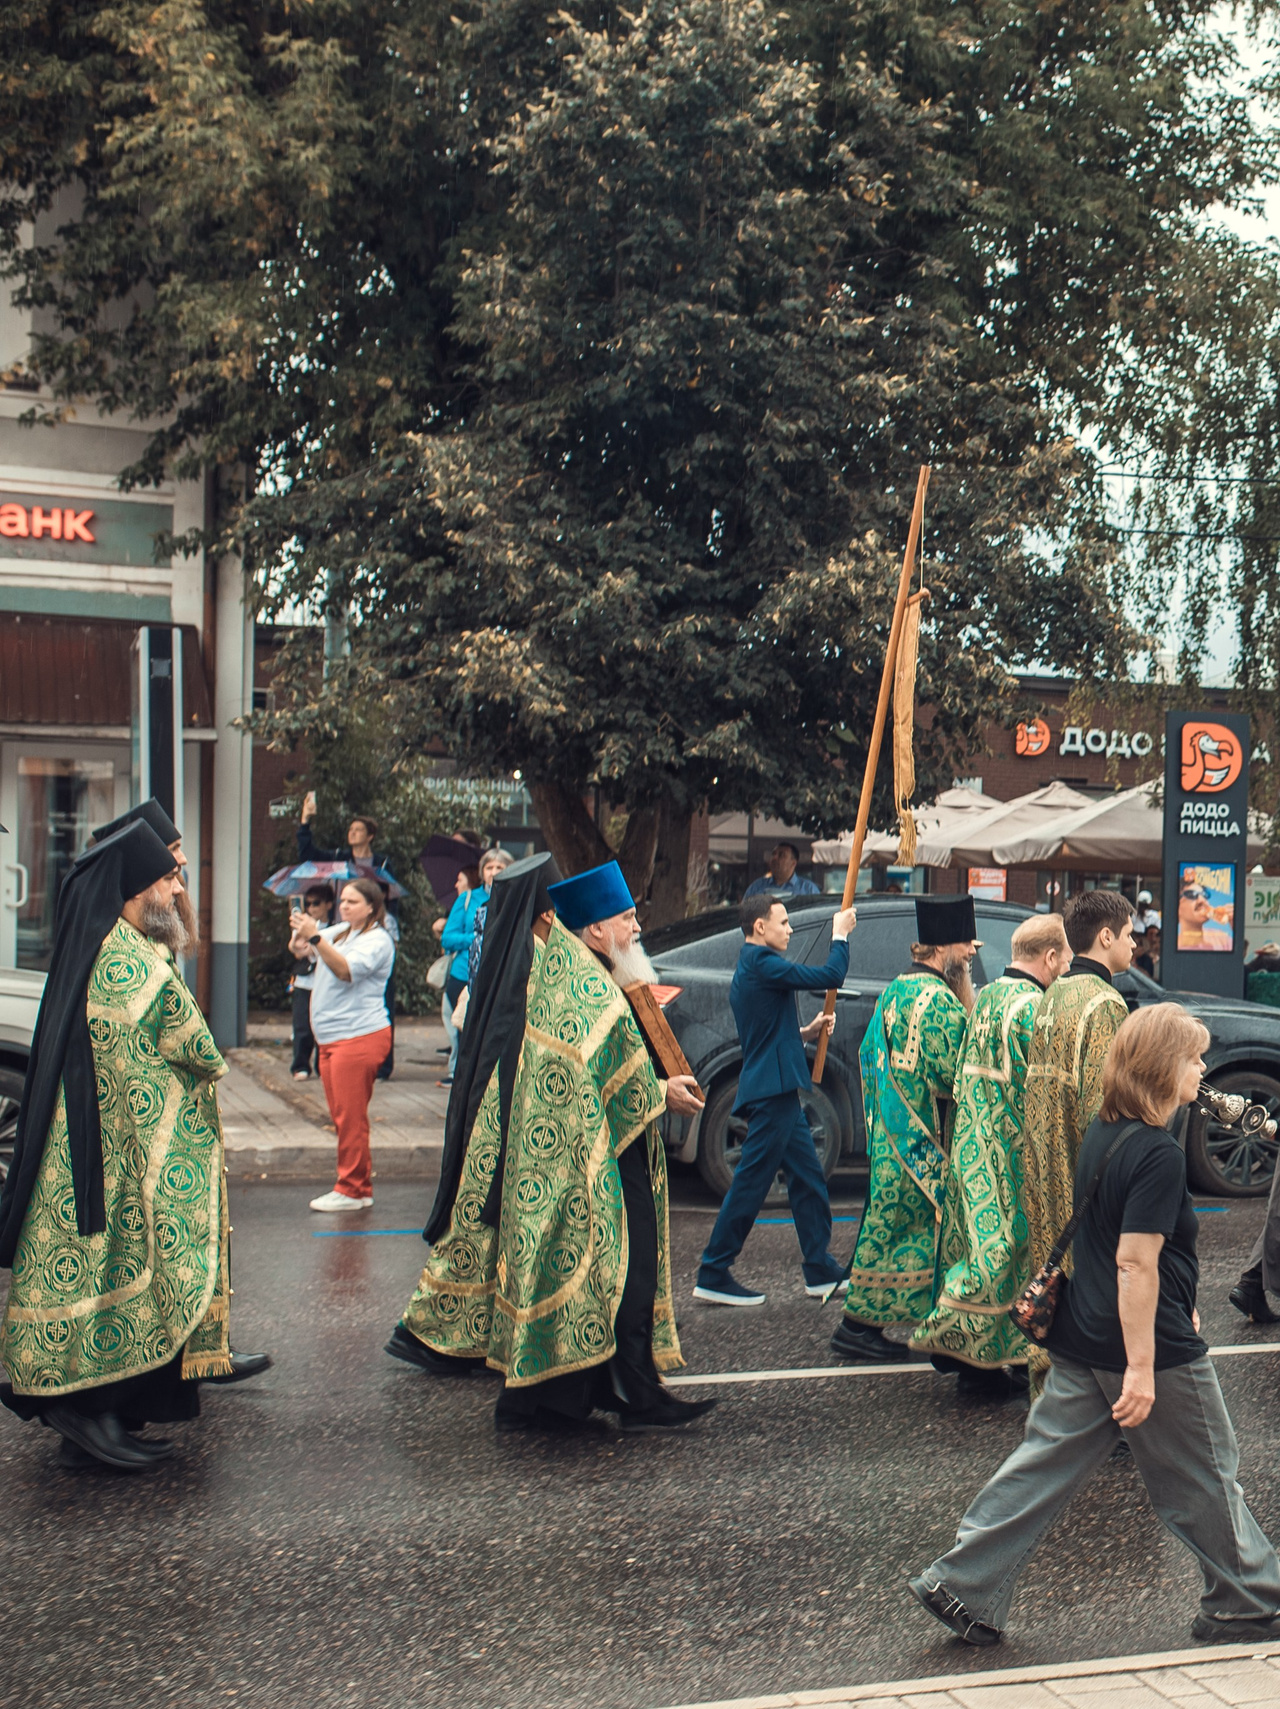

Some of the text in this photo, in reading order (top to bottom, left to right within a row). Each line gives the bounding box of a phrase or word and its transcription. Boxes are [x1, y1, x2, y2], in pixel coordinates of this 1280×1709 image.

[1060, 727, 1153, 759] ДОДО
[1180, 802, 1230, 819] ДОДО
[1180, 819, 1241, 837] ПИЦЦА
